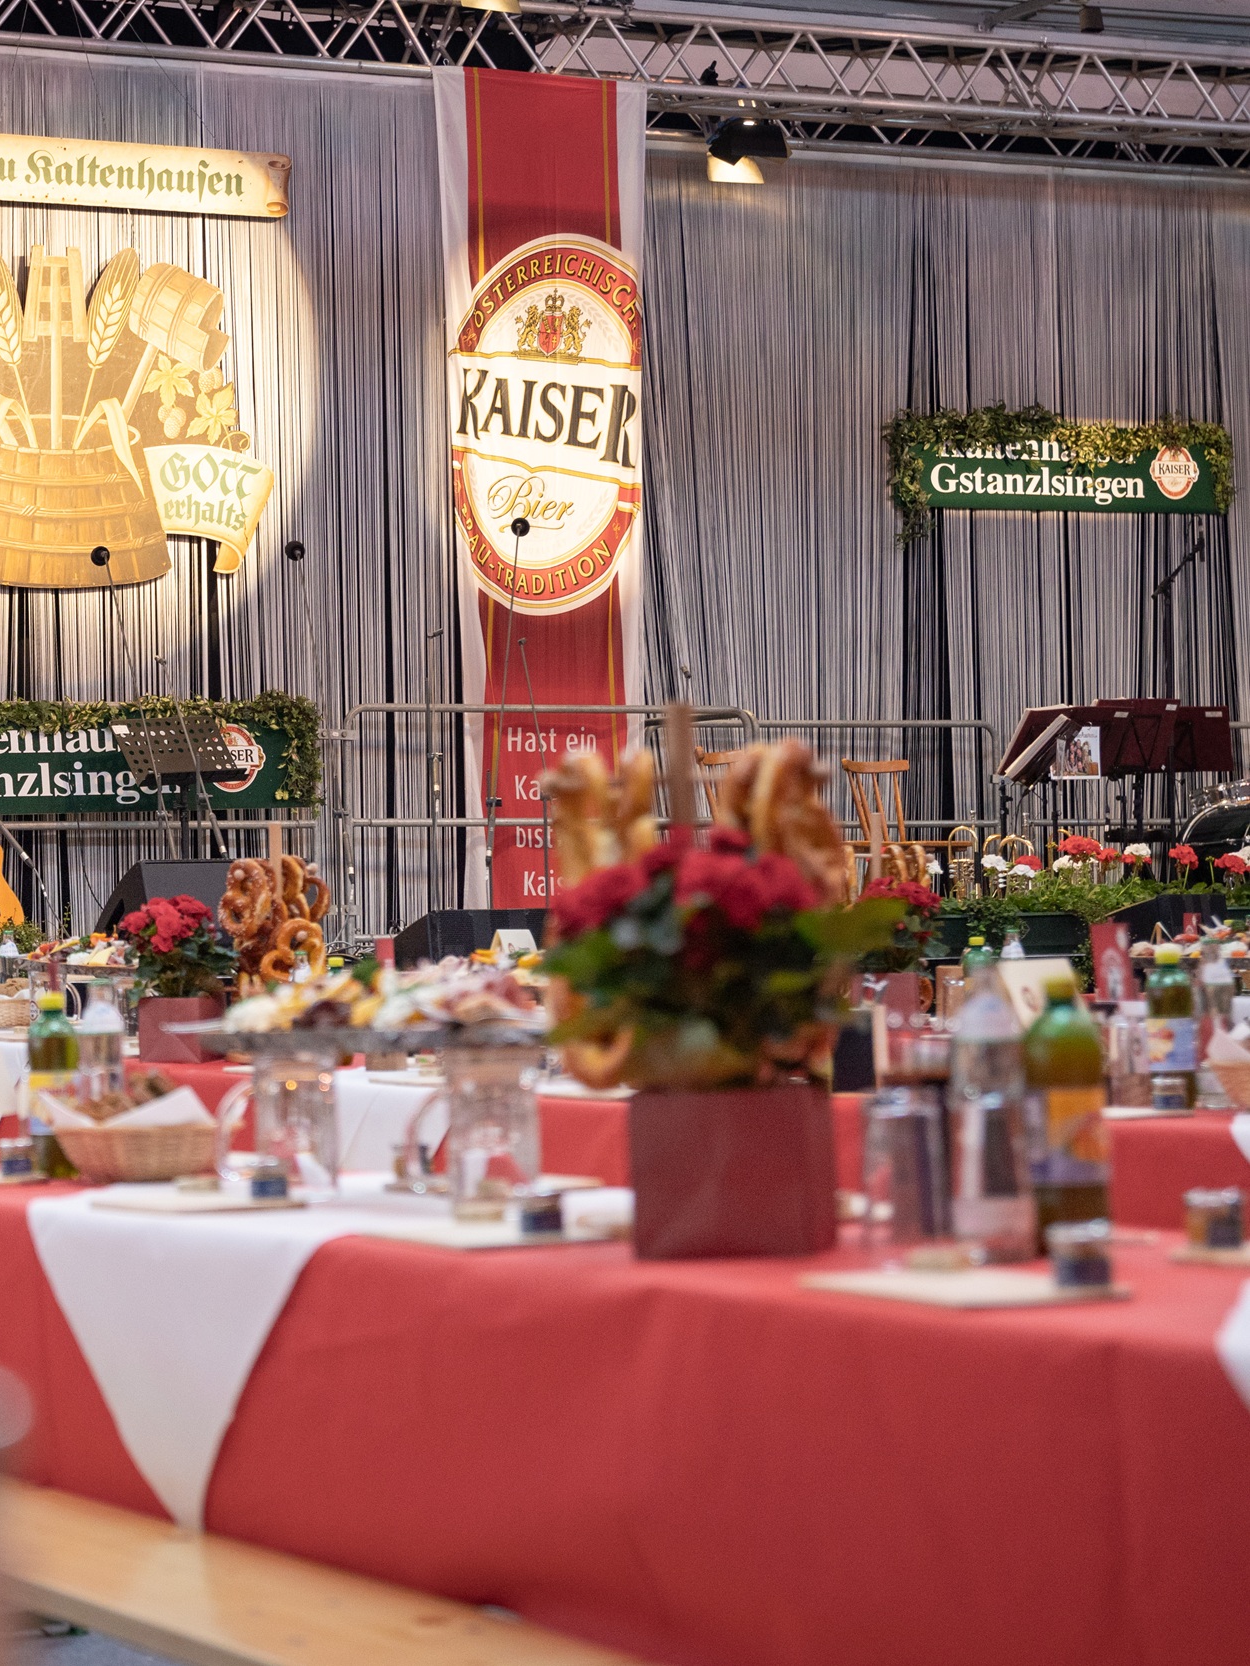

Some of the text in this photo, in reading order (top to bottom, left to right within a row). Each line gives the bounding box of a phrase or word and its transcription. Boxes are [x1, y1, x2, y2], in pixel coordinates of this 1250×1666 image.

[473, 254, 638, 330] ÖSTERREICHISCH
[456, 368, 637, 469] KAISER
[159, 452, 263, 500] GOTT
[930, 462, 1146, 505] Gstanzlsingen
[1158, 463, 1191, 476] KAISER
[163, 493, 249, 531] erhalts
[488, 474, 575, 522] Bier
[230, 748, 255, 763] SER
[507, 727, 597, 753] Hast ein
[516, 825, 553, 849] bist
